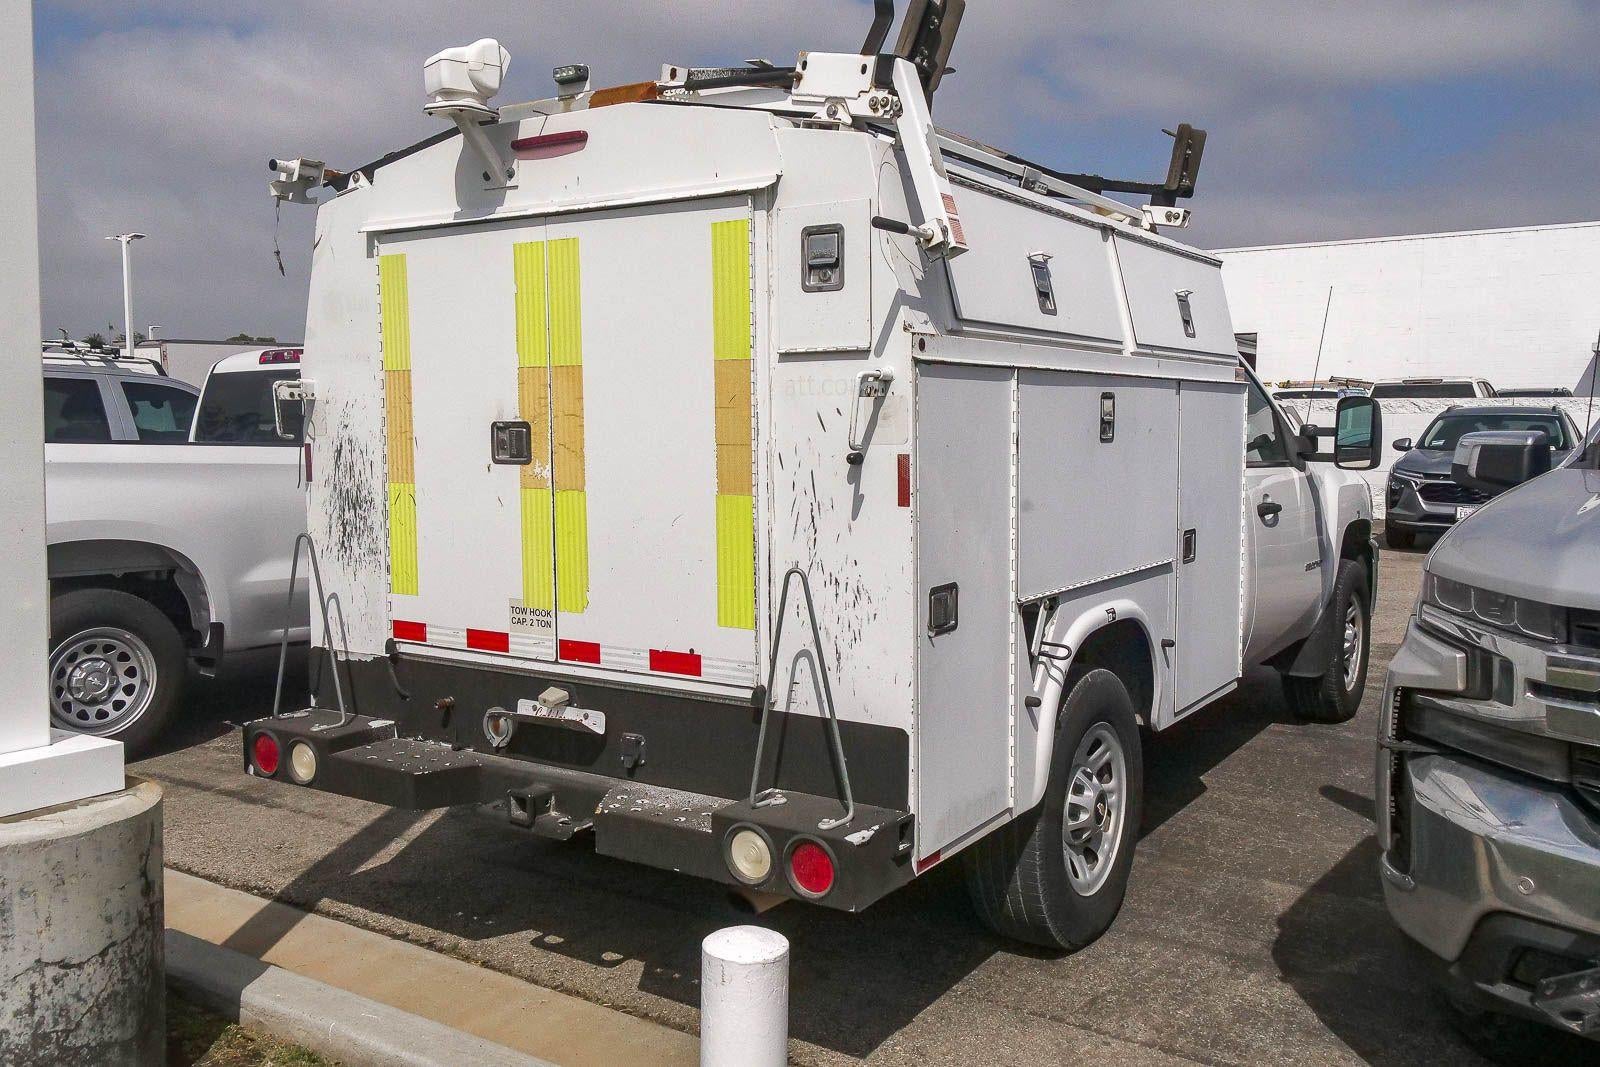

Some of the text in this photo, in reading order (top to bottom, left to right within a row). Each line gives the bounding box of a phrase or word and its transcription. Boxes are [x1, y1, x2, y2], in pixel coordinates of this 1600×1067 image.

[511, 606, 552, 618] TOW HOOK
[511, 616, 552, 628] CAP. 2 TON
